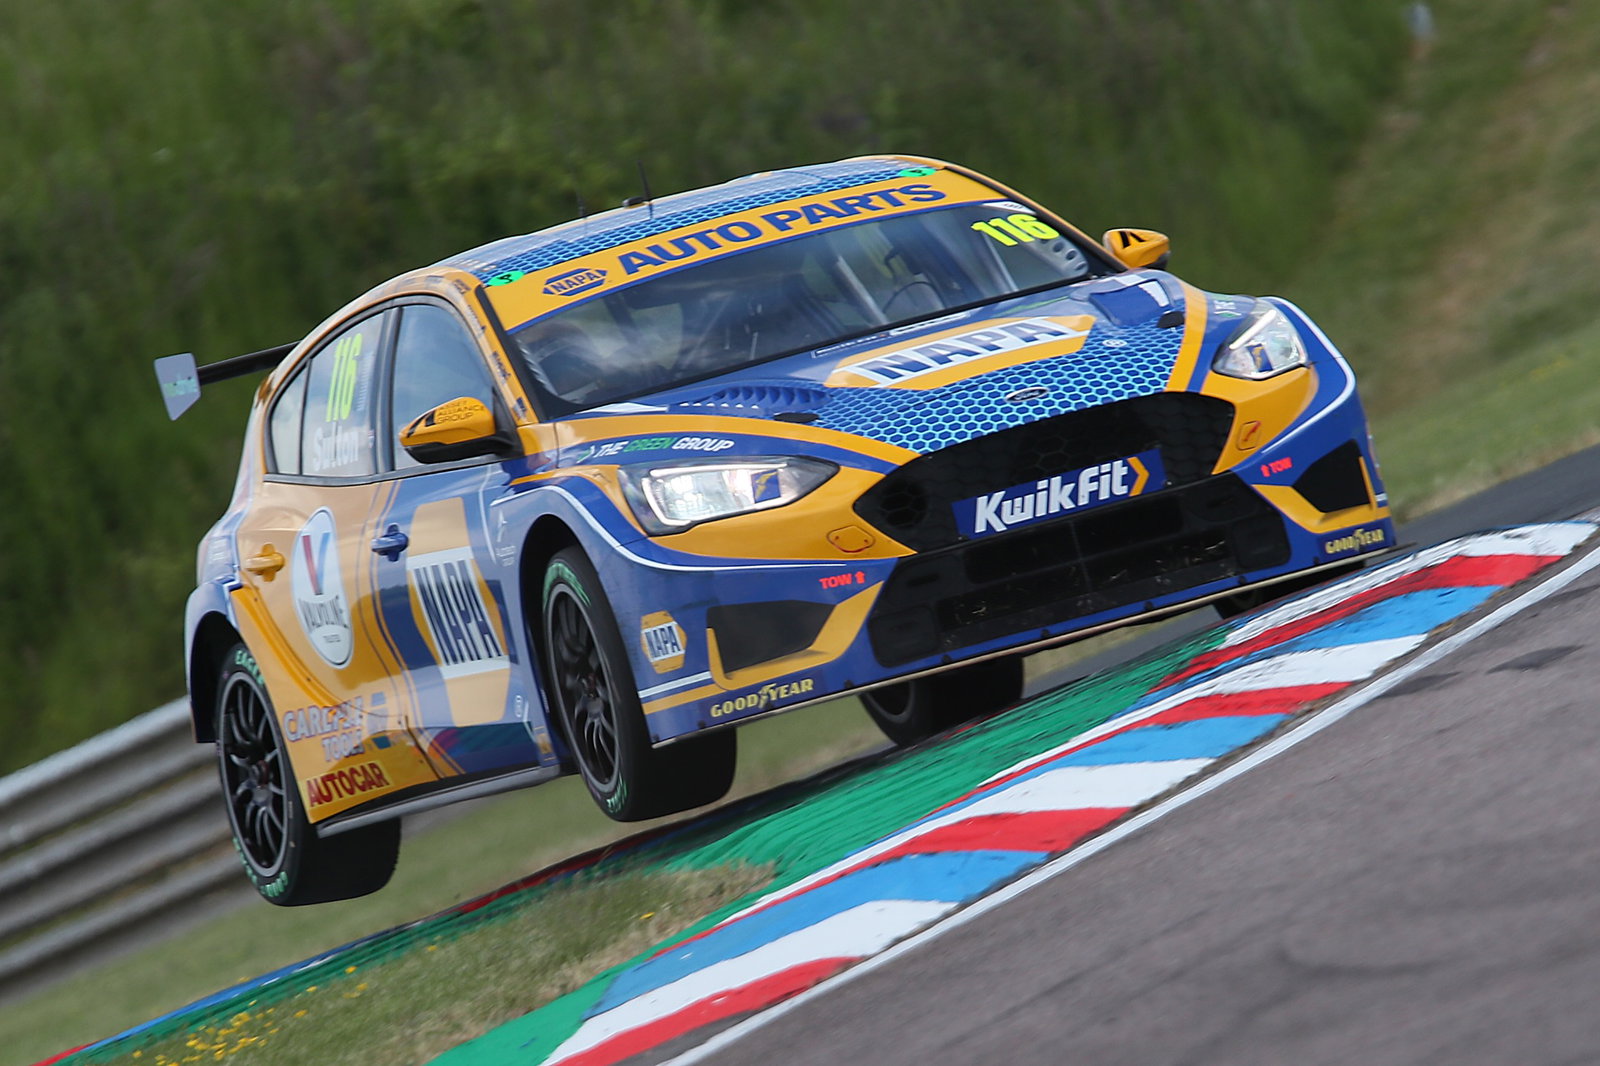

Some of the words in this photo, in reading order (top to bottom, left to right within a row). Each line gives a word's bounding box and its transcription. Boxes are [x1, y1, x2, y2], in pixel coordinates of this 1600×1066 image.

[550, 271, 602, 293] NAPA
[617, 220, 764, 275] AUTO
[760, 184, 947, 232] PARTS
[971, 213, 1060, 248] 116
[855, 321, 1065, 380] NAPA
[325, 333, 363, 423] 116
[437, 411, 474, 424] GROUP
[593, 441, 630, 458] THE
[624, 437, 679, 452] GREEN
[672, 436, 735, 452] GROUP
[1268, 457, 1293, 474] TOW
[819, 573, 853, 590] TOW
[414, 558, 502, 666] NAPA
[644, 625, 681, 658] NAPA
[710, 678, 815, 718] GOODYEAR
[306, 762, 390, 808] AUTOCAR
